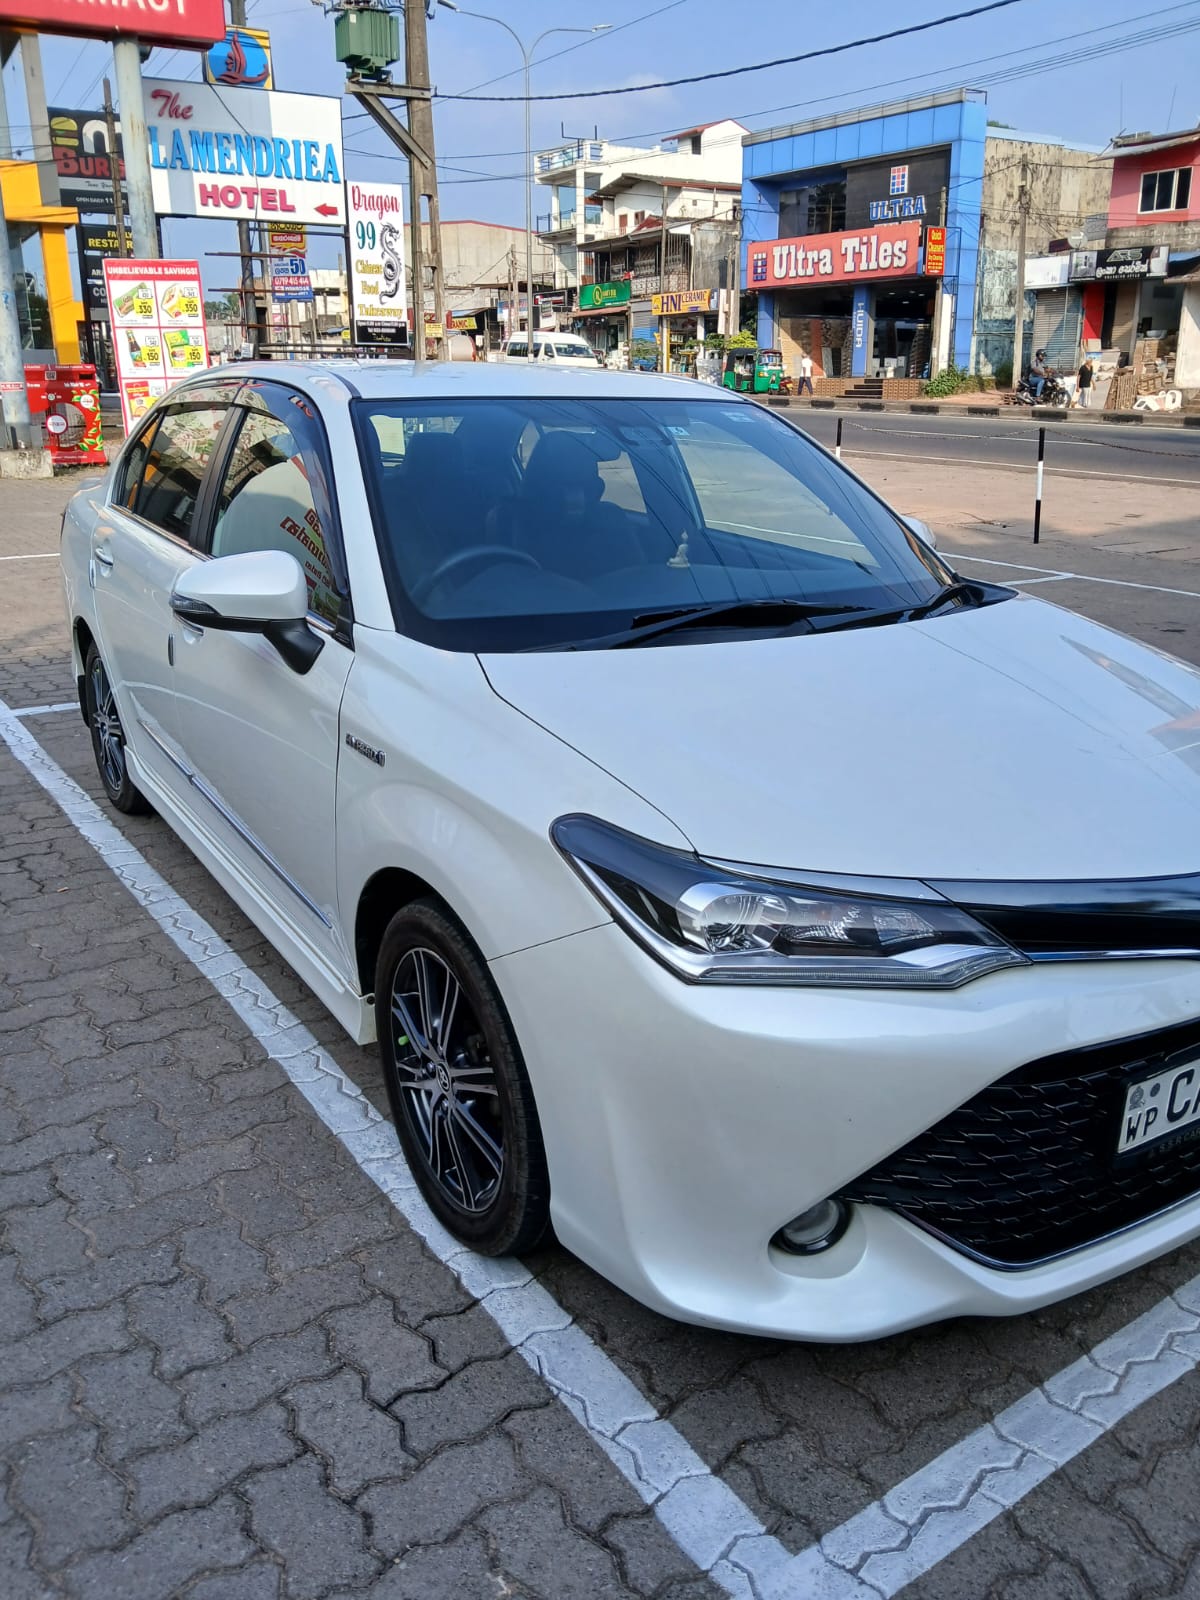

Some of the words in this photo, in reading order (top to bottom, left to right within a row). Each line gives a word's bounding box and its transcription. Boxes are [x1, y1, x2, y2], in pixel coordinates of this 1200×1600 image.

[151, 89, 193, 119] The
[147, 126, 341, 183] LAMENDRIEA
[199, 183, 296, 212] HOTEL
[352, 185, 399, 220] Dragon
[869, 195, 927, 221] ULTRA
[107, 231, 132, 239] FALY
[356, 220, 376, 249] 99
[88, 238, 133, 249] RESTAR
[772, 244, 833, 279] Ultra
[841, 234, 907, 273] Tiles
[107, 266, 162, 275] UNBELIEVABLE
[163, 266, 198, 275] SAVINGS!
[356, 259, 383, 274] Chinese
[361, 280, 379, 295] Food
[682, 290, 707, 303] CERAMIC
[138, 304, 152, 314] 330
[184, 303, 198, 313] 350
[855, 302, 865, 348] HUIDA
[146, 352, 159, 361] 150
[189, 351, 201, 360] 150
[1125, 1106, 1158, 1144] WP
[1167, 1068, 1200, 1122] C
